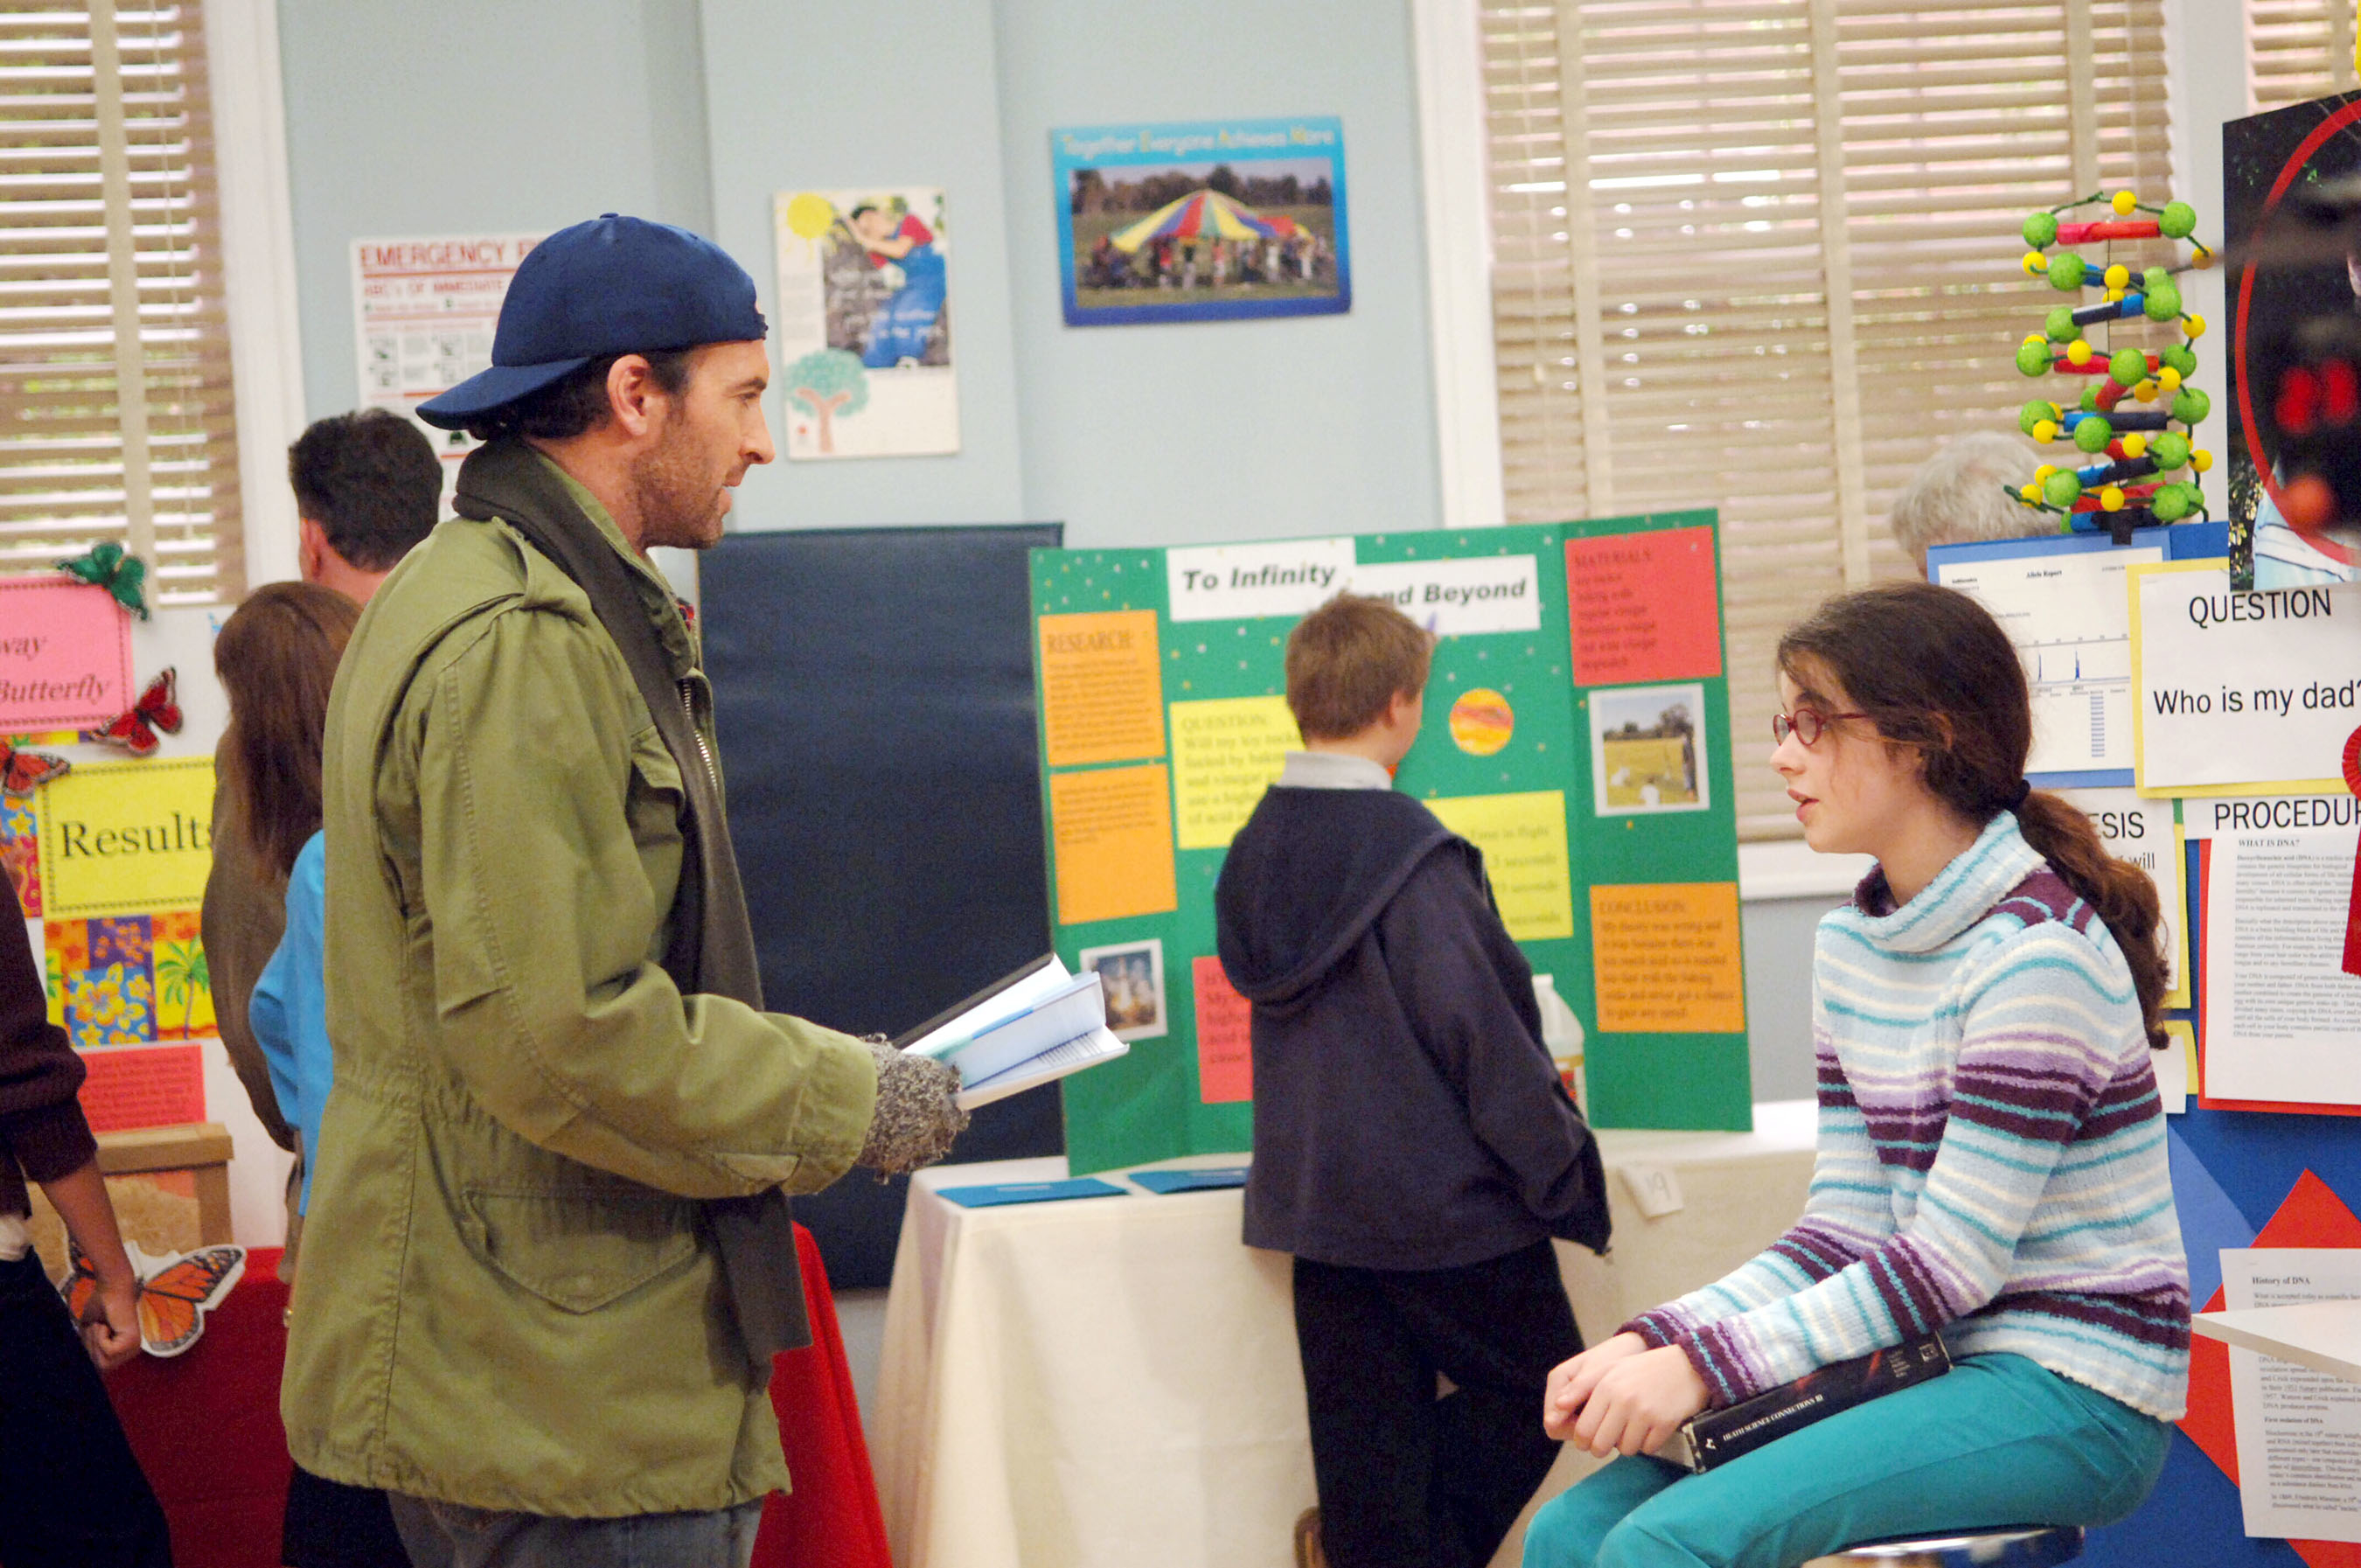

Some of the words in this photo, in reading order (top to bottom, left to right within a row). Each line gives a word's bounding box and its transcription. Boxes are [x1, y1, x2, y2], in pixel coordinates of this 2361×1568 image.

[360, 240, 506, 268] EMERGENCY
[1183, 570, 1219, 590] To
[1230, 564, 1336, 588] Infinity
[1424, 577, 1527, 606] Beyond
[2189, 588, 2332, 629] QUESTION
[2154, 689, 2211, 714] Who
[2222, 686, 2244, 713] is
[2253, 689, 2294, 716] my
[2239, 839, 2264, 847] WHAT
[2277, 839, 2301, 847] DNA?
[2252, 1276, 2281, 1286] History
[2292, 1276, 2310, 1285] DNA
[1745, 1416, 1772, 1432] SCIENCE
